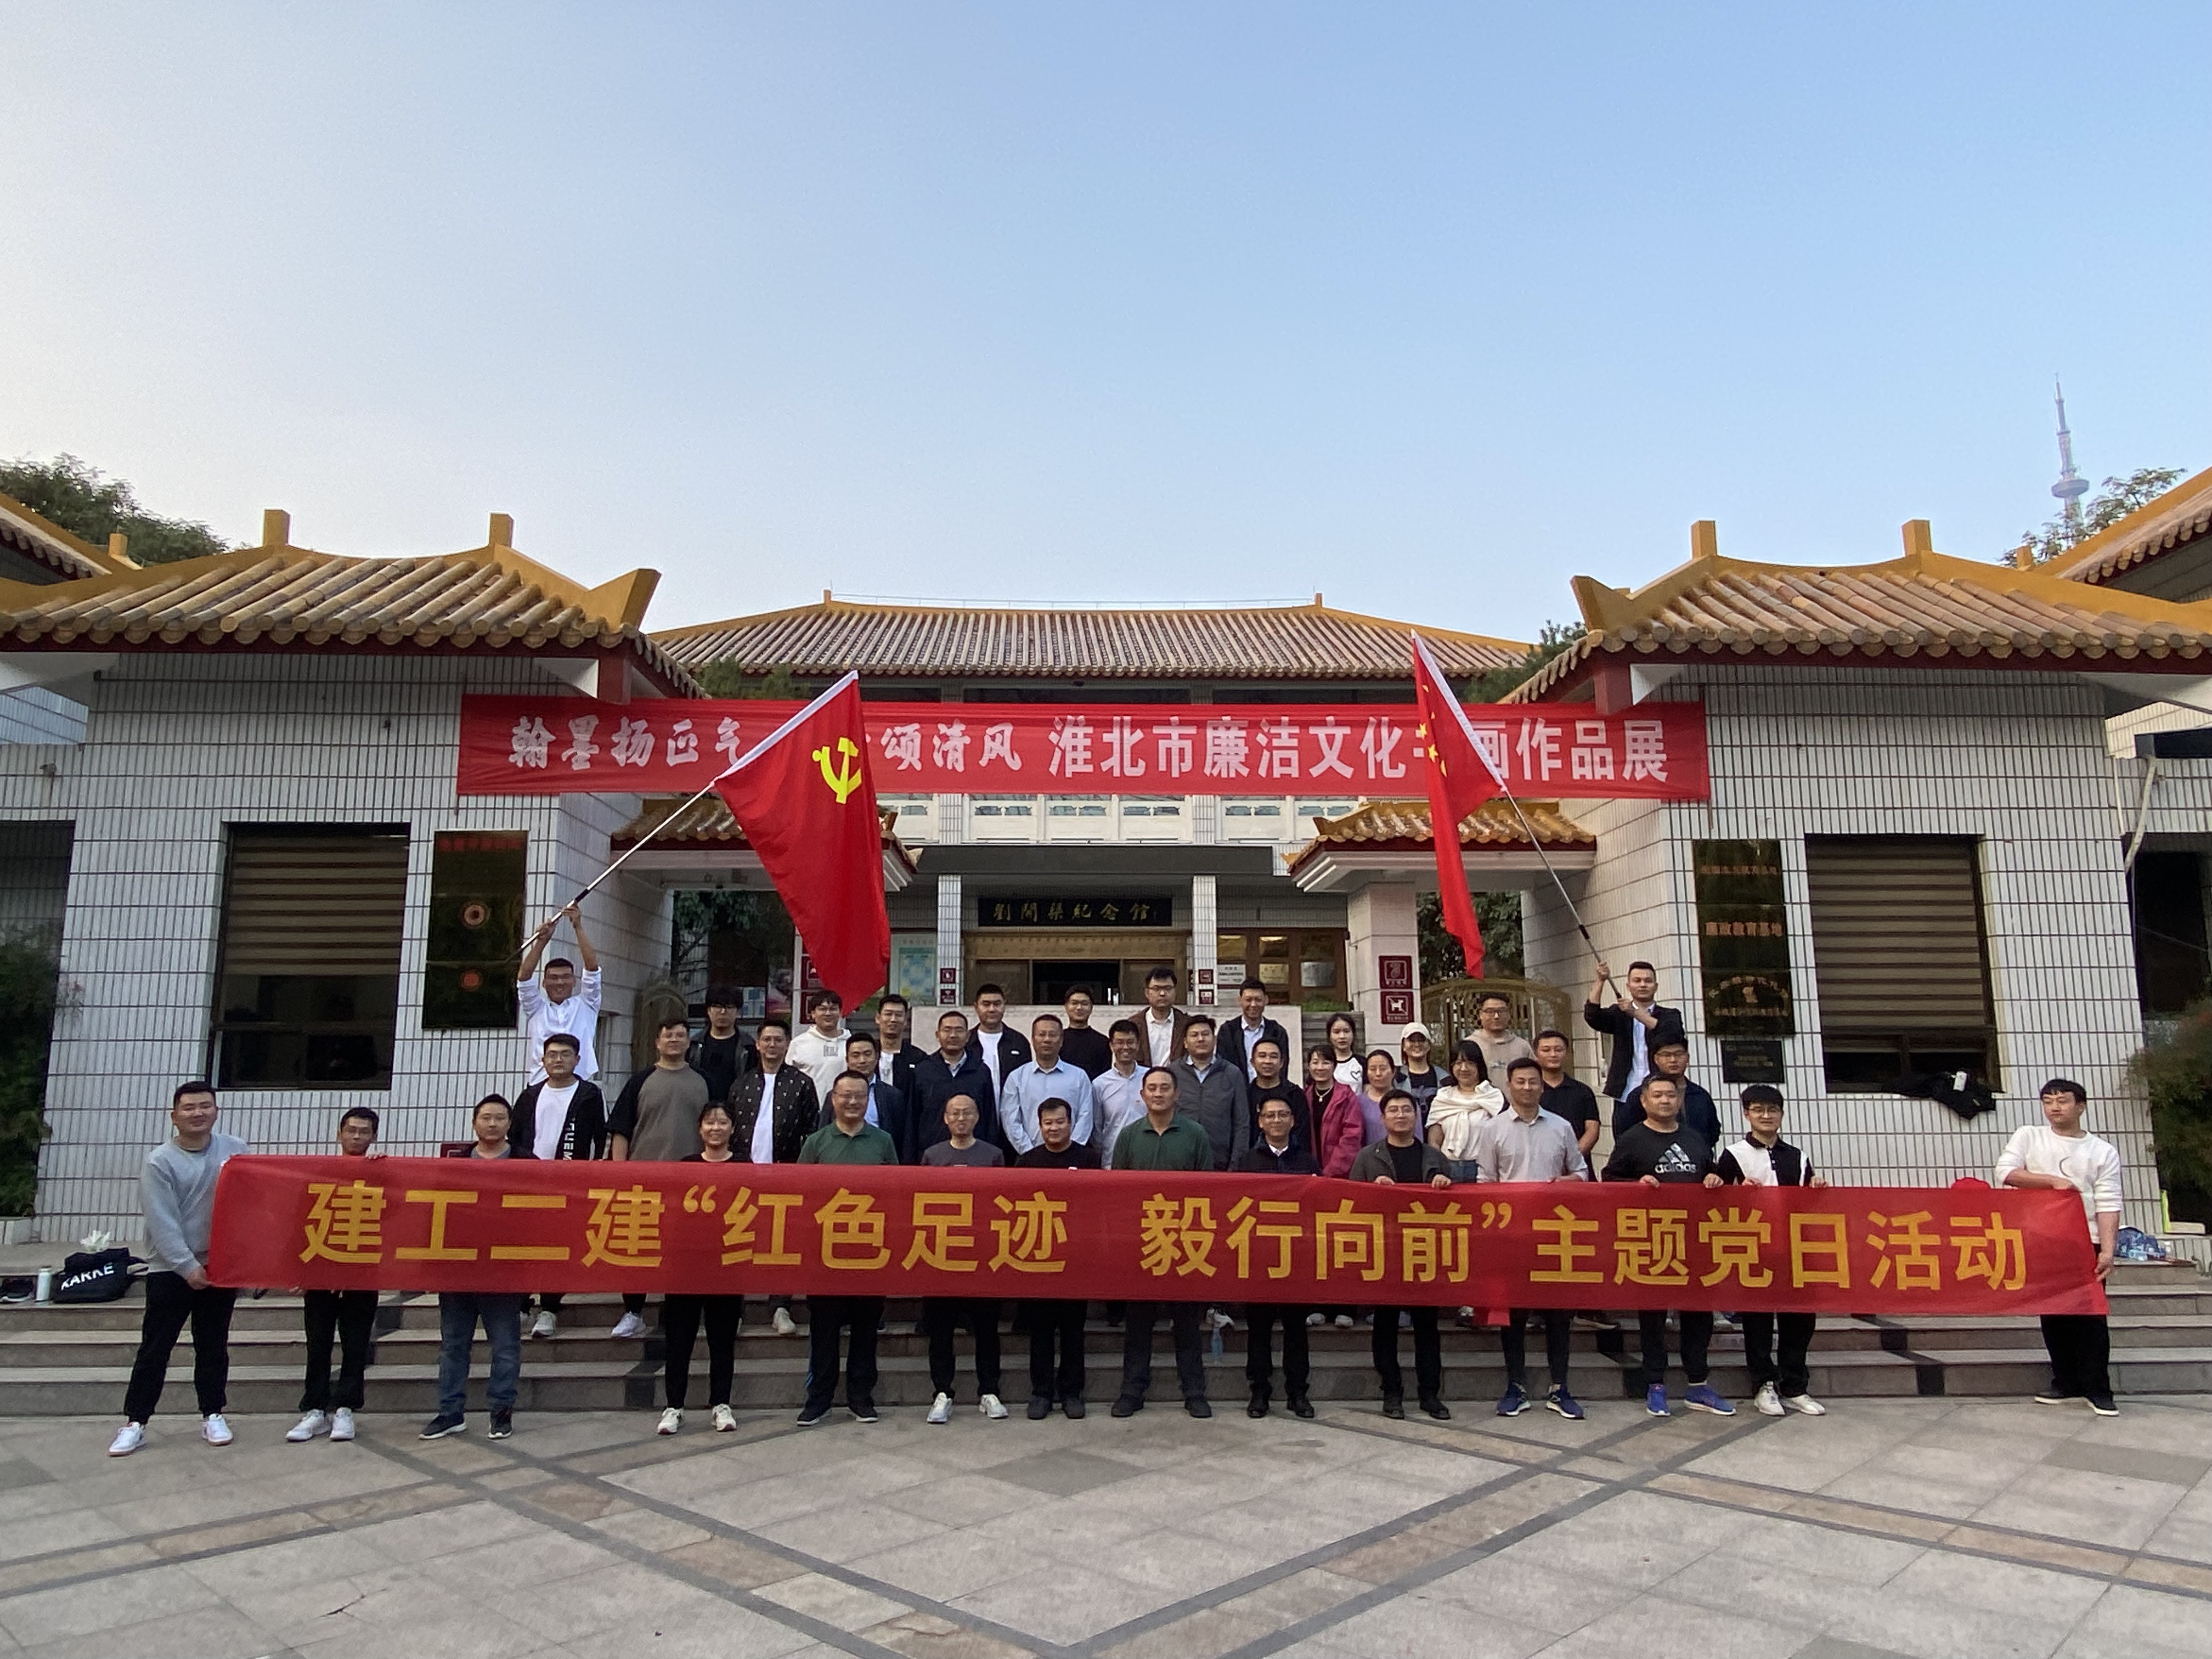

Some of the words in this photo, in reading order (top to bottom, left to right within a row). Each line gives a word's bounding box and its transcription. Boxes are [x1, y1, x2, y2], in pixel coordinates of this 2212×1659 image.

[508, 716, 742, 771] 翰墨扬正气
[865, 718, 1023, 772] 颂清风
[1047, 715, 1669, 783] 淮北市廉洁文化画作品展
[1654, 1161, 1697, 1173] adidas
[300, 1179, 1069, 1273] 建工二建“红色足迹
[1140, 1193, 2028, 1291] 毅行向前”主题党日活动
